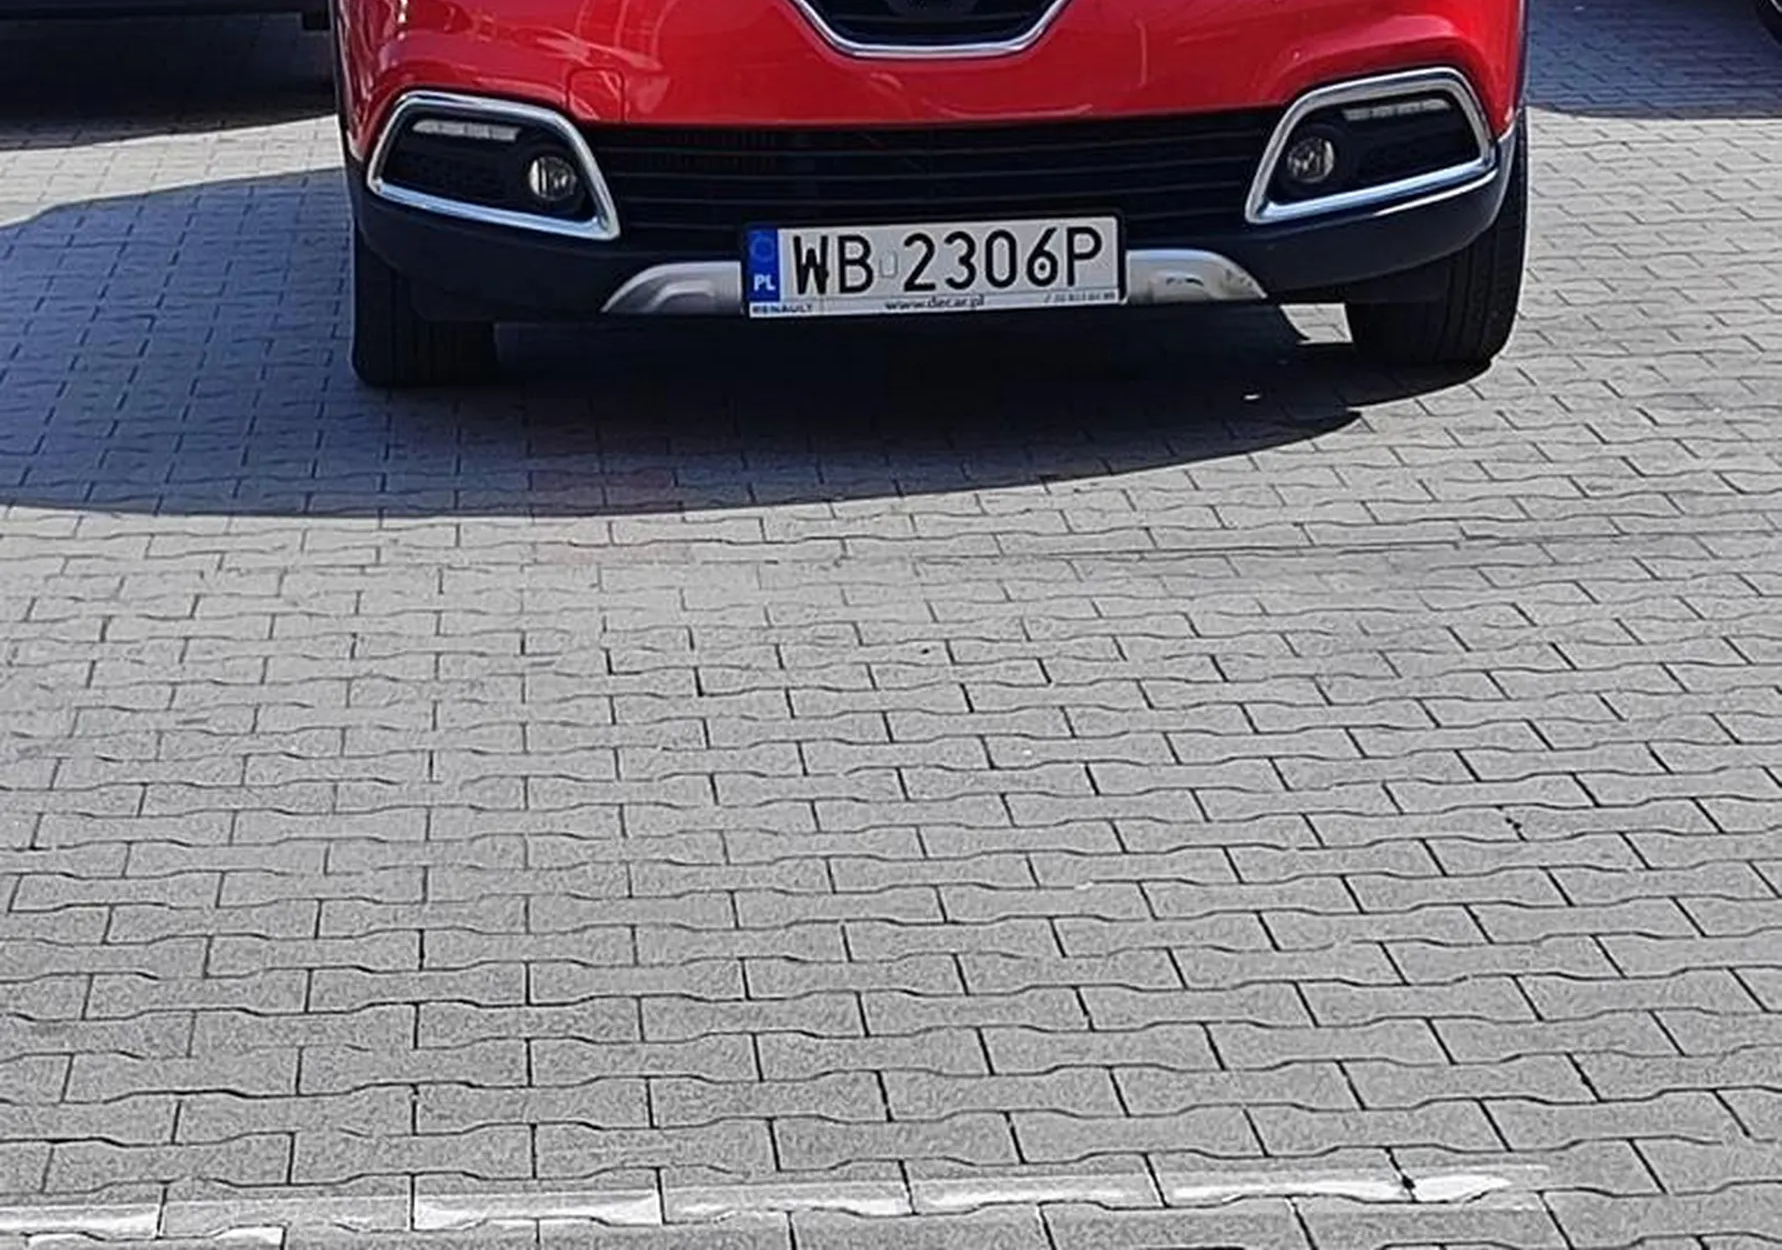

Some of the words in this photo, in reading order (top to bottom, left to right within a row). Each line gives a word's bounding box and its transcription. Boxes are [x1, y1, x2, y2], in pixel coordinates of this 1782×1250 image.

[792, 235, 874, 295] WB
[903, 226, 1102, 291] 2306P
[753, 274, 776, 291] PL
